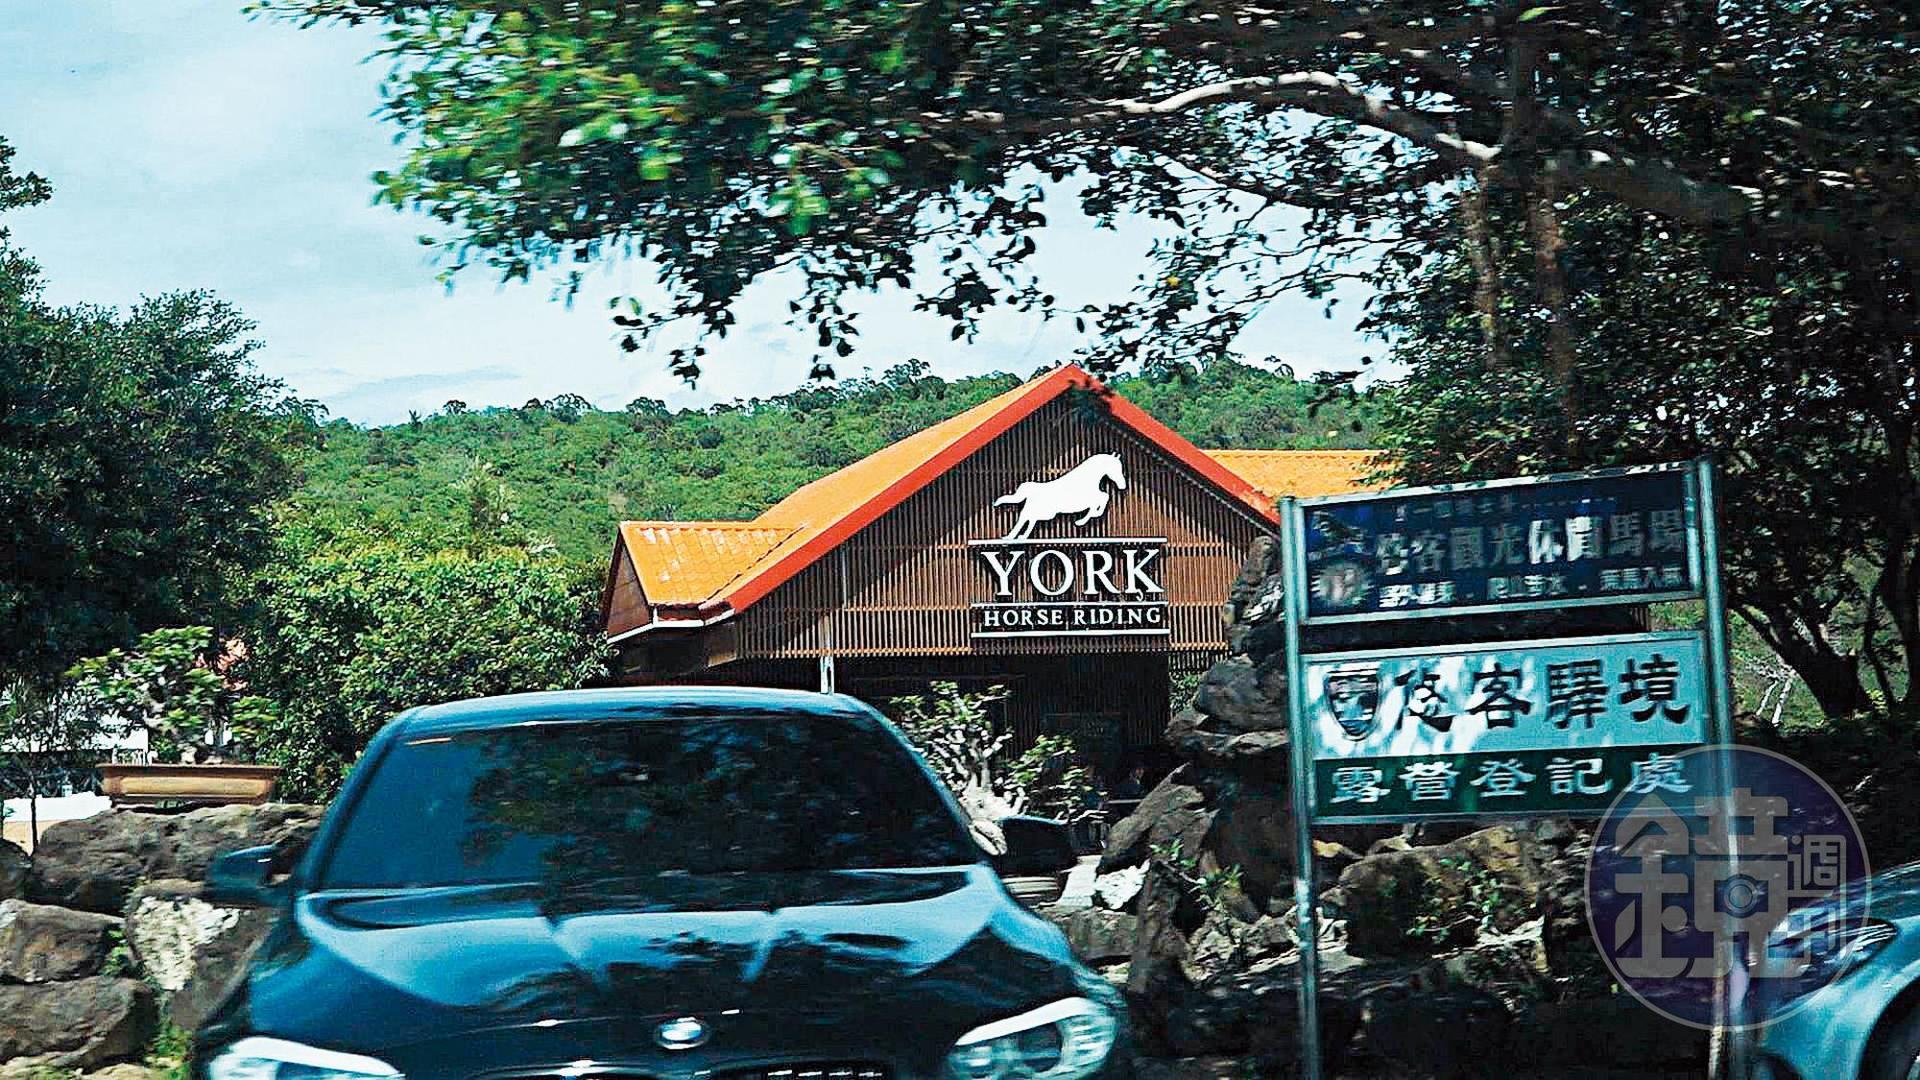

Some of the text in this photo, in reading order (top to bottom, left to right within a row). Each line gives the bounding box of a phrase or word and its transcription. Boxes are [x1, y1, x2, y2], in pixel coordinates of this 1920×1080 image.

[981, 549, 1165, 601] YORK
[984, 607, 1160, 627] HORSE RIDING
[1330, 752, 1692, 803] 露營登記處
